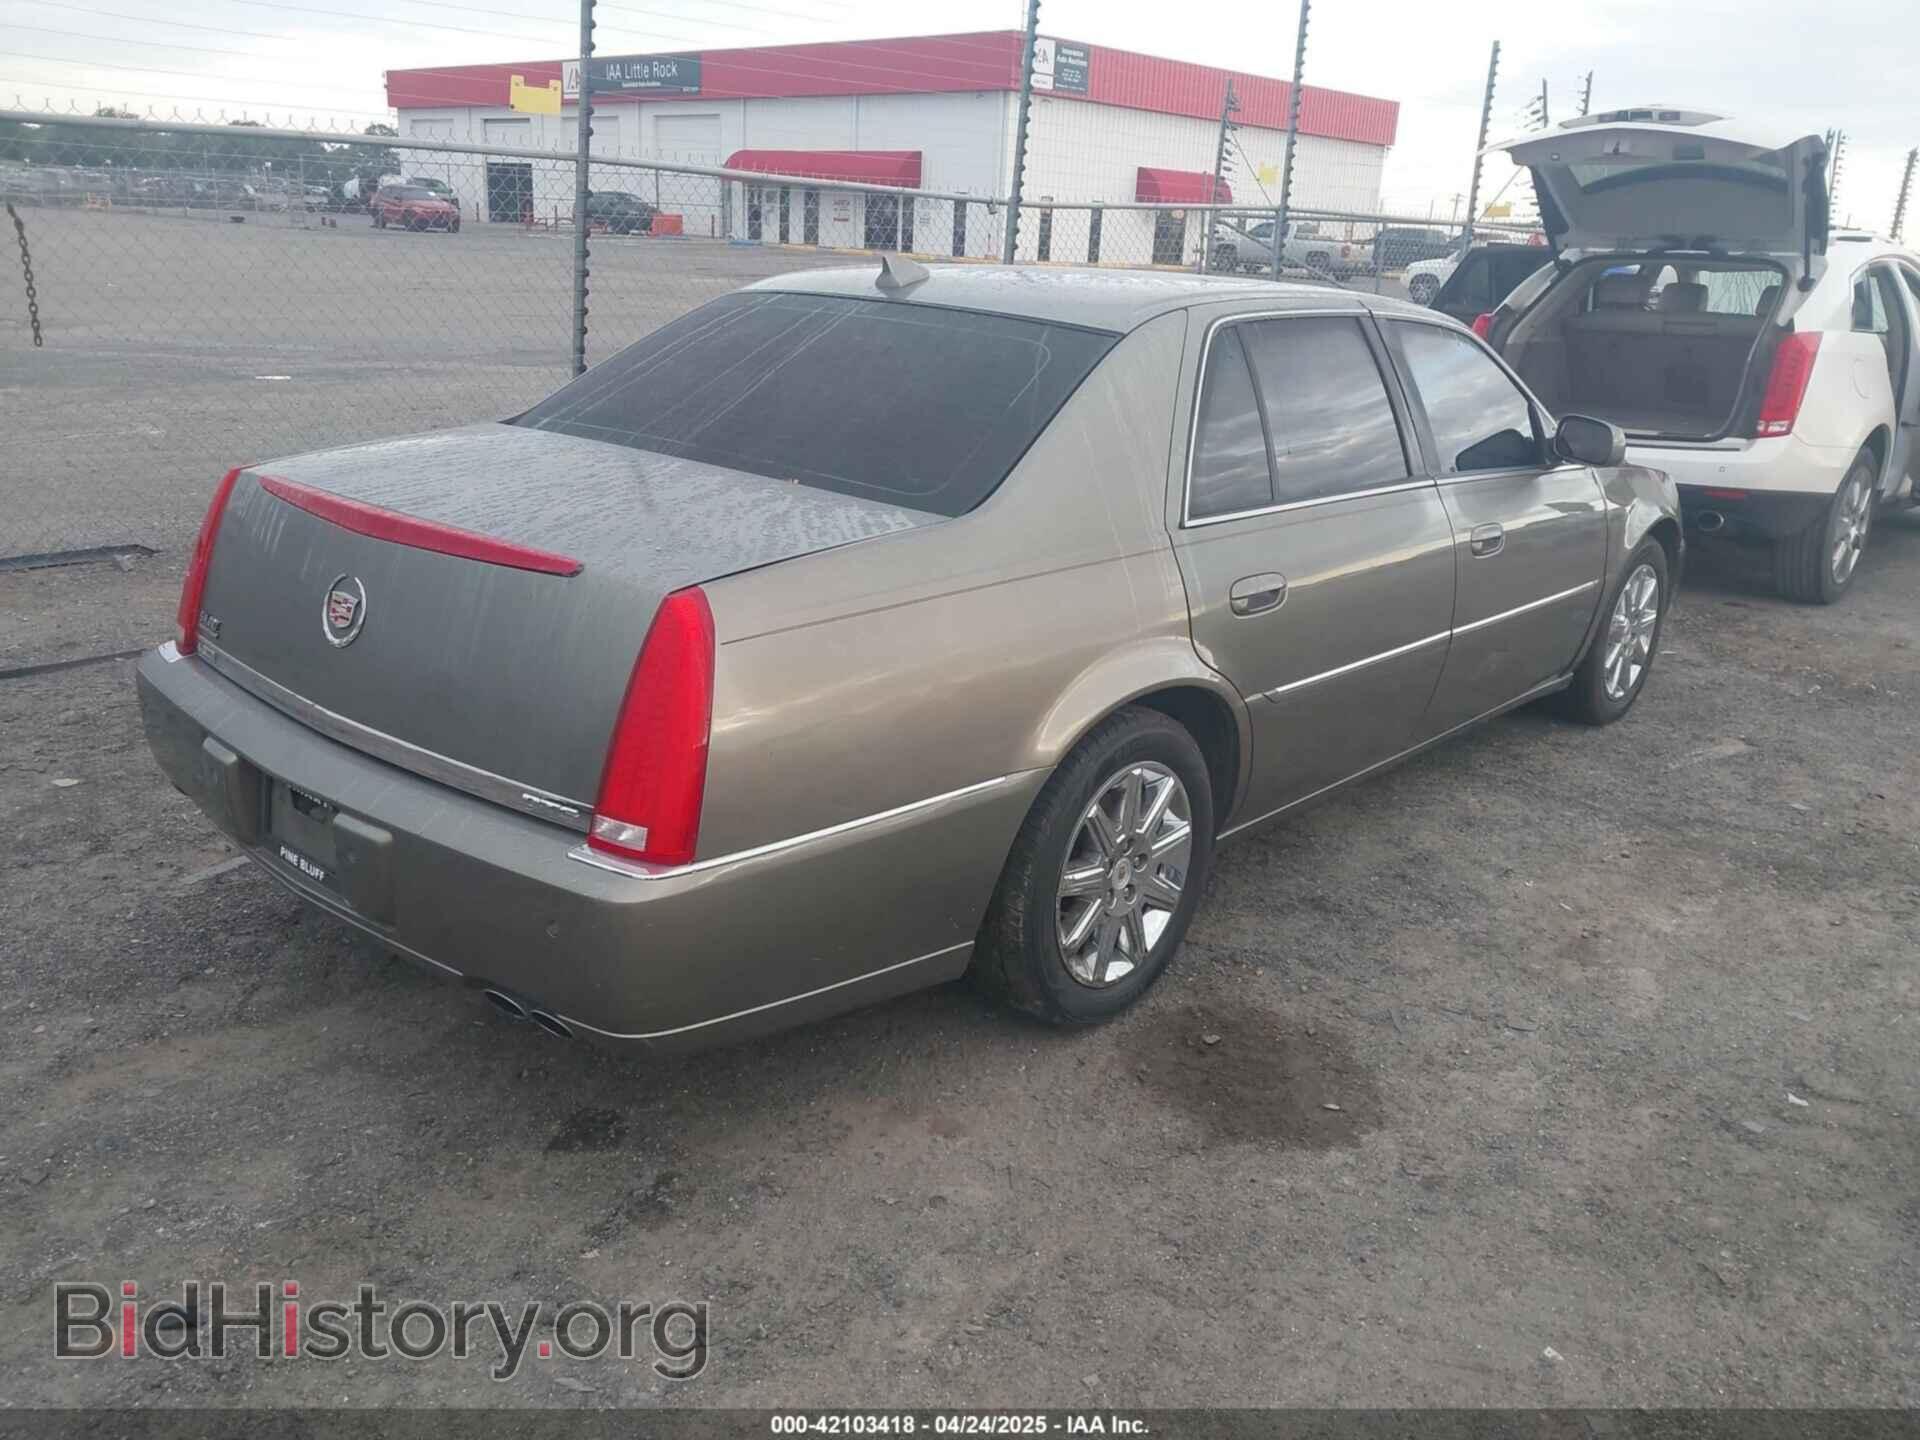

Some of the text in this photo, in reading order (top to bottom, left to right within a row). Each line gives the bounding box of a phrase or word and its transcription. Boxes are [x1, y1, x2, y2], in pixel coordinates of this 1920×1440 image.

[606, 61, 678, 80] IAA Little Rock
[280, 845, 325, 881] PINE BLUFF
